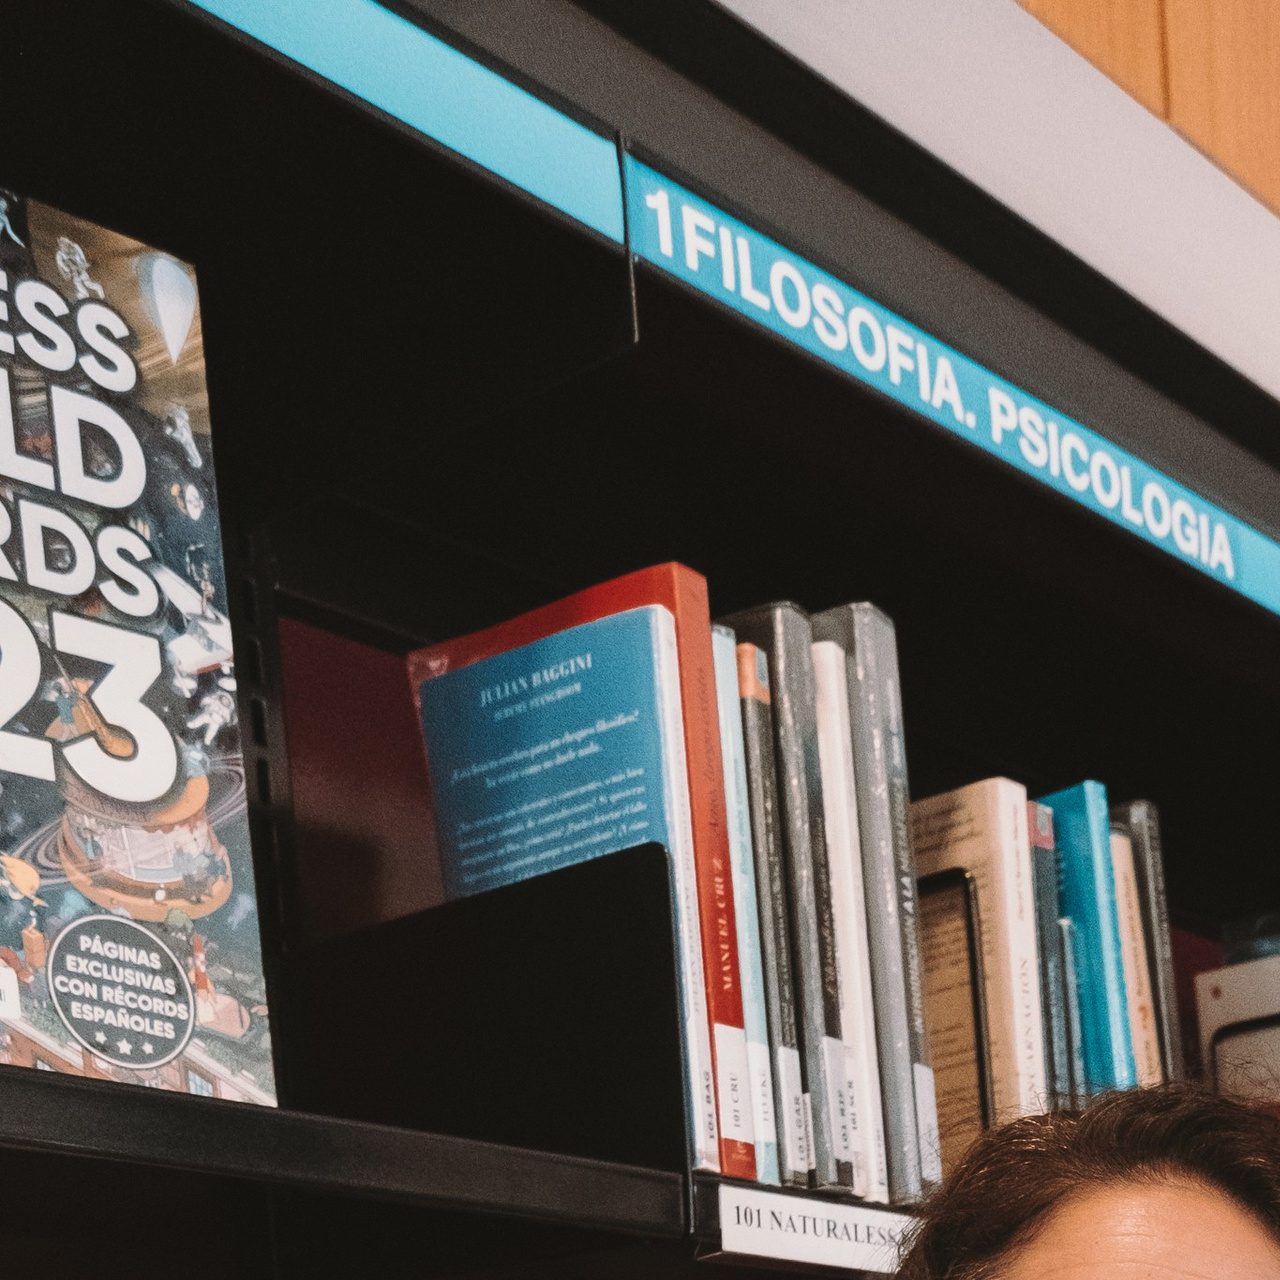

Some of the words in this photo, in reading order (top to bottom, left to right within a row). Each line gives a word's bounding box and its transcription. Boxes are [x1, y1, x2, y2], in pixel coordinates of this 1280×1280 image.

[988, 386, 1235, 580] PSICOLOGIA
[480, 678, 528, 708] JULIAN
[711, 857, 726, 911] CRUZ
[80, 934, 161, 970] PÁGINAS
[716, 916, 733, 992] MANUEL
[66, 954, 176, 995] EXCLUSIVAS
[54, 974, 98, 1000] CON
[102, 985, 188, 1020] RÉCORDS
[71, 1001, 175, 1039] ESPAÑOLES
[702, 1070, 712, 1105] BAG
[730, 1071, 740, 1104] CRU
[733, 1108, 742, 1128] 101
[735, 1205, 761, 1228] 101
